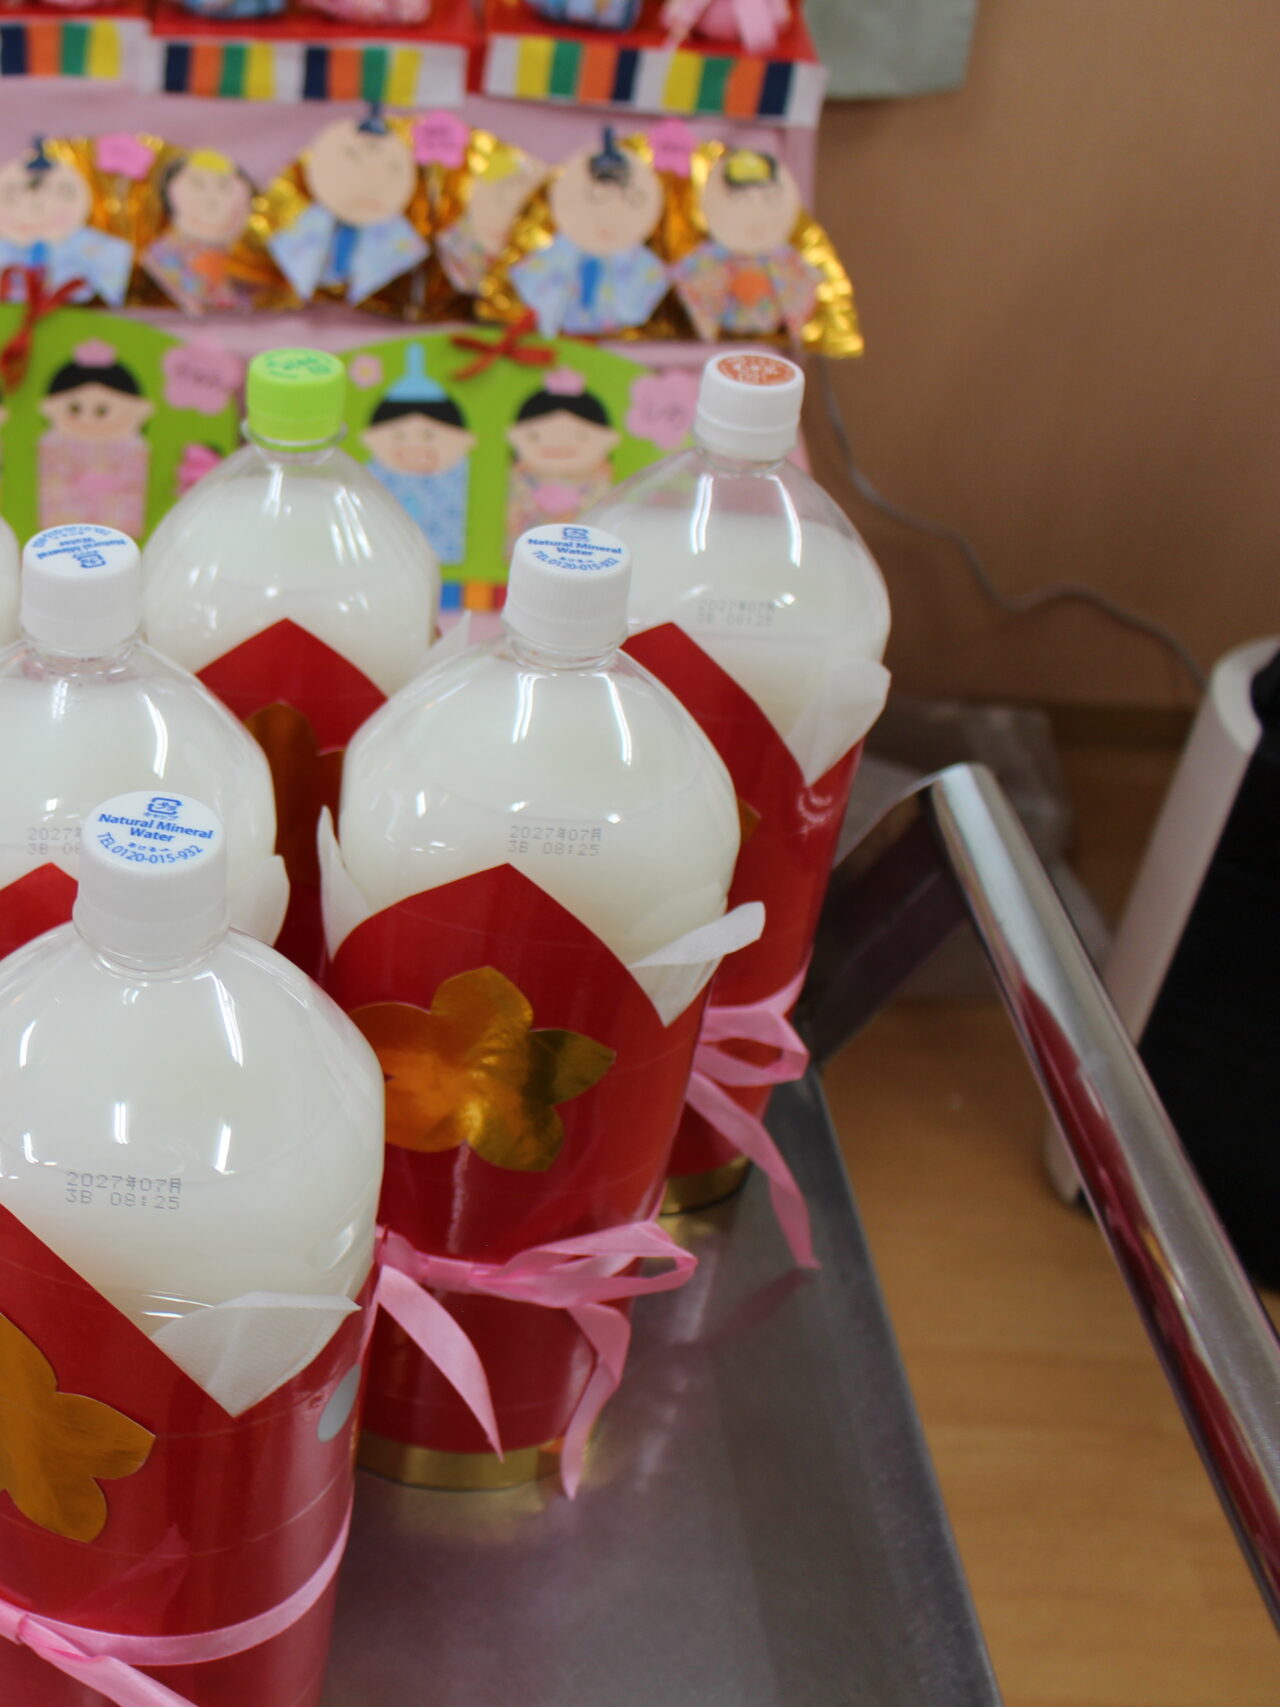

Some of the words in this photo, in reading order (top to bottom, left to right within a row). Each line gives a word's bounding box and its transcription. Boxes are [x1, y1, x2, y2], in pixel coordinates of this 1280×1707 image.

[527, 538, 574, 548] Natural
[575, 542, 622, 554] Mineral
[556, 546, 594, 556] Water
[98, 813, 154, 829] Natural
[156, 820, 214, 840] Mineral
[129, 827, 175, 842] Water
[97, 832, 116, 849] TEL
[111, 844, 204, 864] 0120-015-932
[66, 1171, 182, 1194] 2027年07月
[65, 1187, 93, 1205] 3B
[110, 1191, 181, 1211] 08:25
